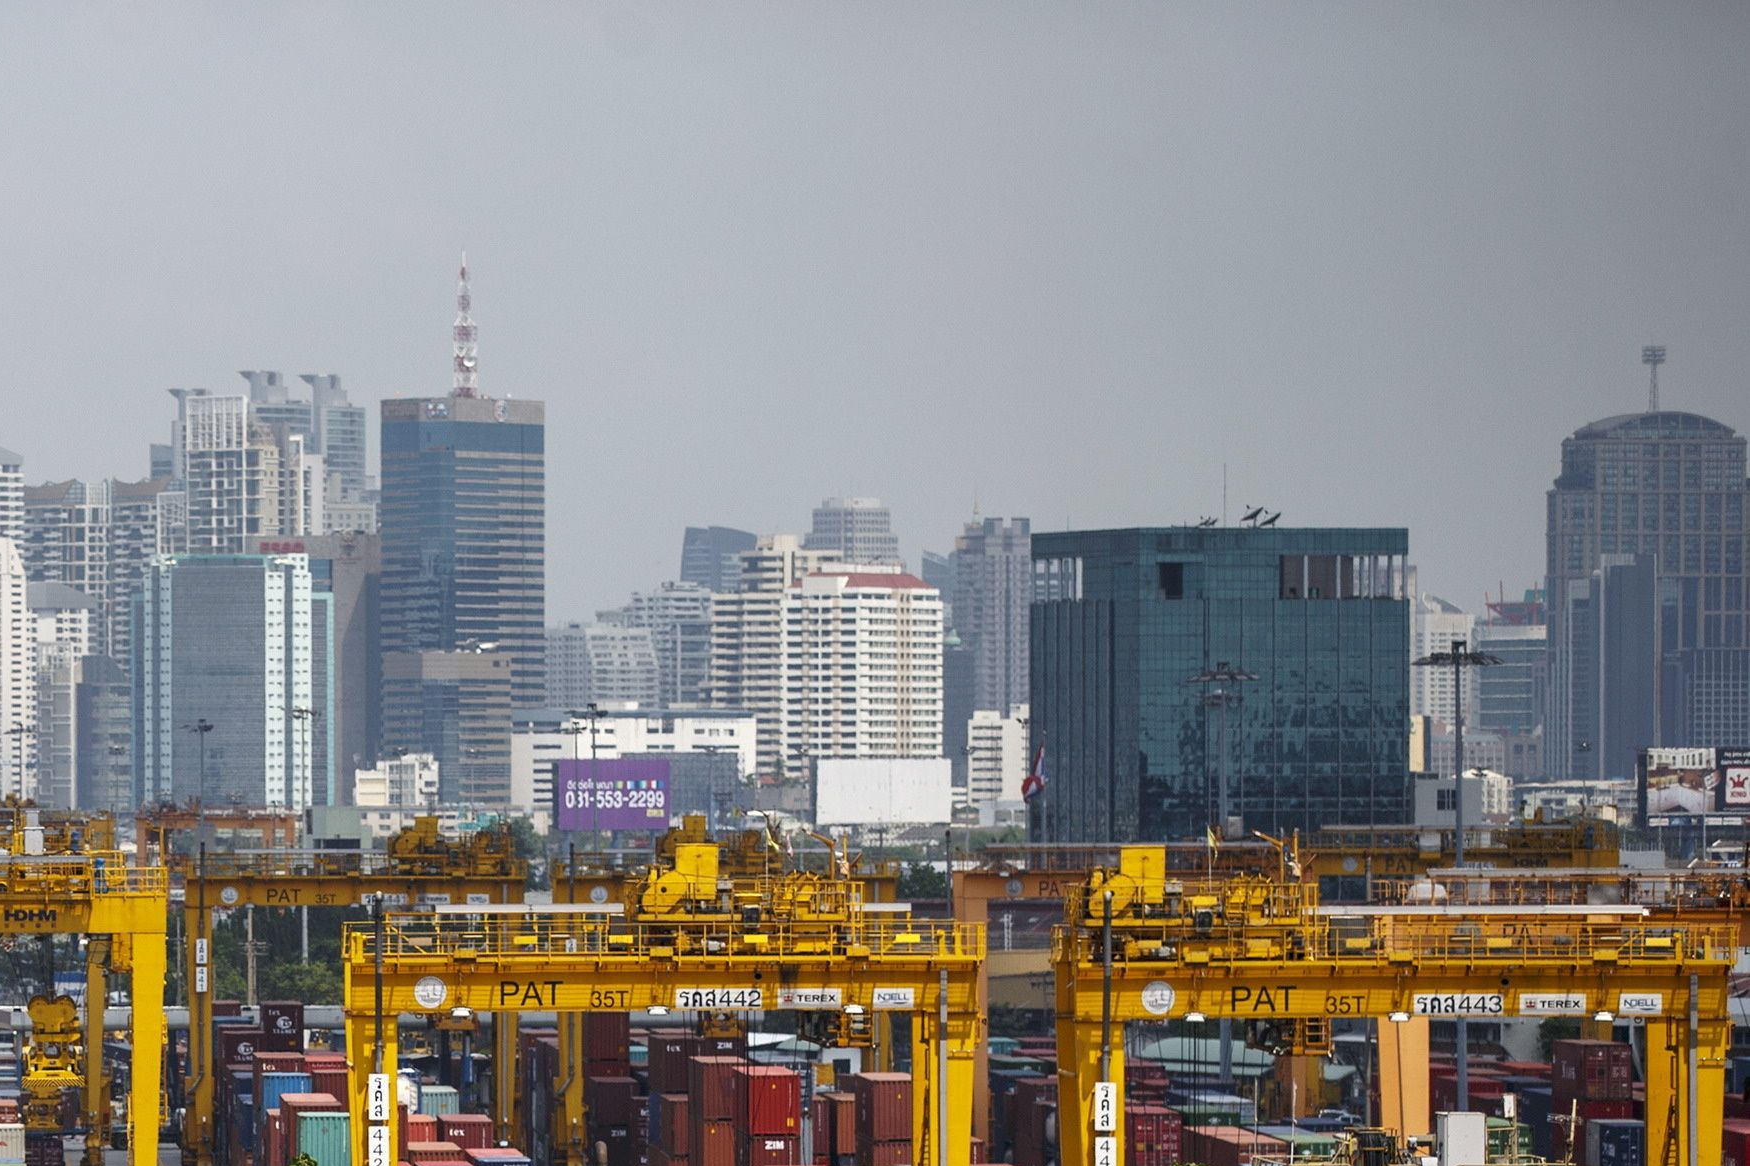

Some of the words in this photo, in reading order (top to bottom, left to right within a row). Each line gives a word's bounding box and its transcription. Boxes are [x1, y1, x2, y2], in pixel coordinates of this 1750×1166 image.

[266, 888, 301, 904] PAT
[499, 980, 563, 1007] PAT
[590, 990, 630, 1008] 35T
[678, 988, 762, 1008] รคส442
[796, 994, 836, 1003] TEREX
[1230, 985, 1297, 1012] PAT
[1325, 996, 1366, 1014] 35T
[1416, 995, 1503, 1014] รคส443
[1539, 1000, 1581, 1009] TEREX
[716, 1041, 733, 1049] ZIM
[374, 1077, 383, 1117] รคส
[1100, 1085, 1110, 1127] รคส
[449, 1128, 466, 1137] tex
[610, 1129, 627, 1138] ZIM
[764, 1140, 785, 1150] ZIM
